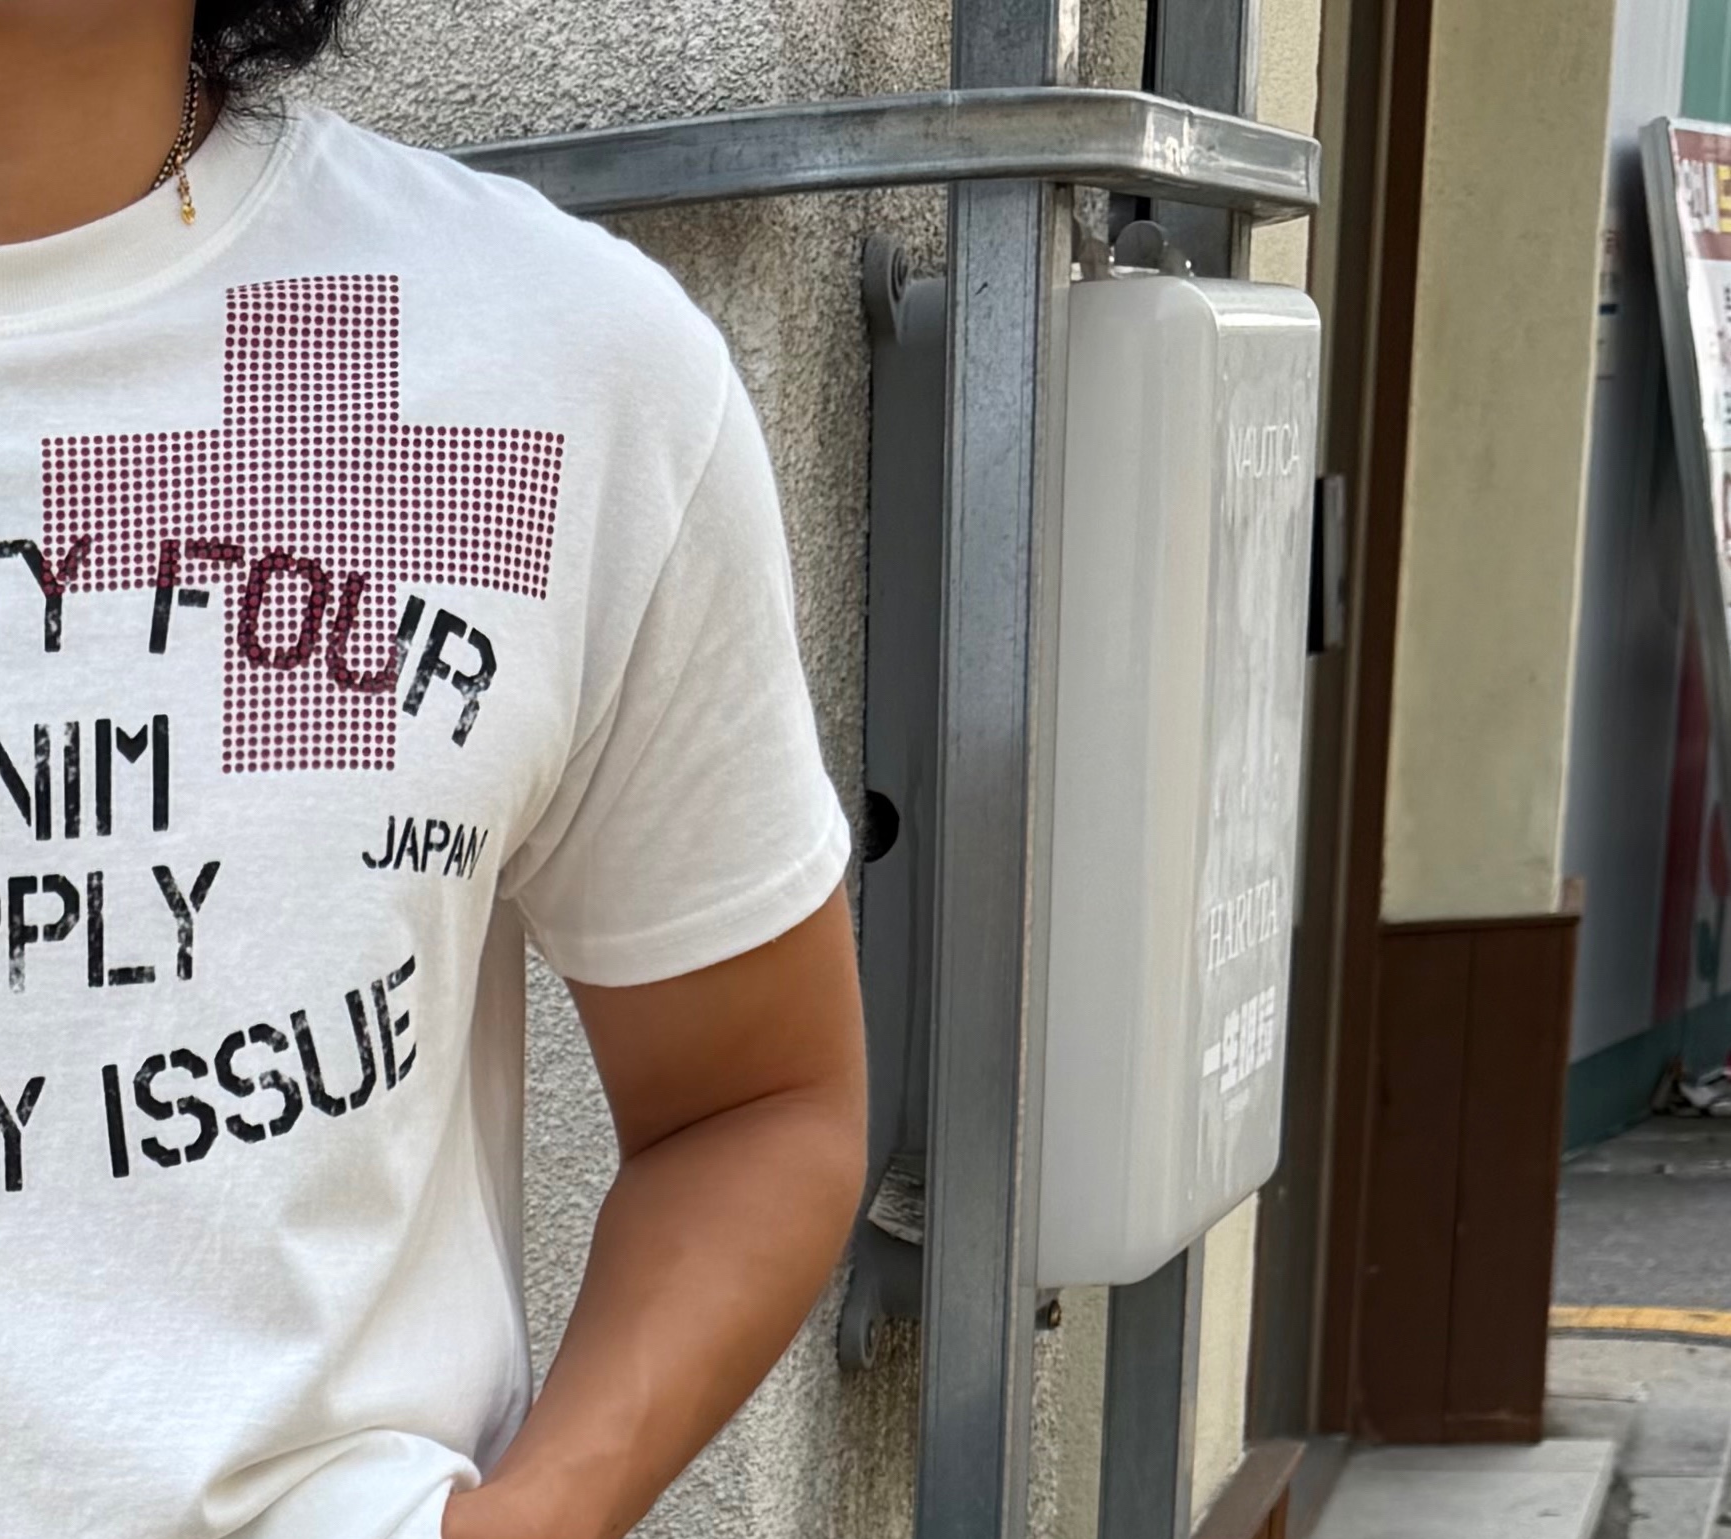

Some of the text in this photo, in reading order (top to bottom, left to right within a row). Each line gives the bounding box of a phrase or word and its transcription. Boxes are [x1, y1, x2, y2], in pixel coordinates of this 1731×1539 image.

[1226, 420, 1300, 478] NAUTICA
[147, 536, 498, 748] FOUR
[361, 814, 488, 880] JAPAN
[1207, 876, 1279, 973] HARUTA
[100, 954, 417, 1180] ISSUE
